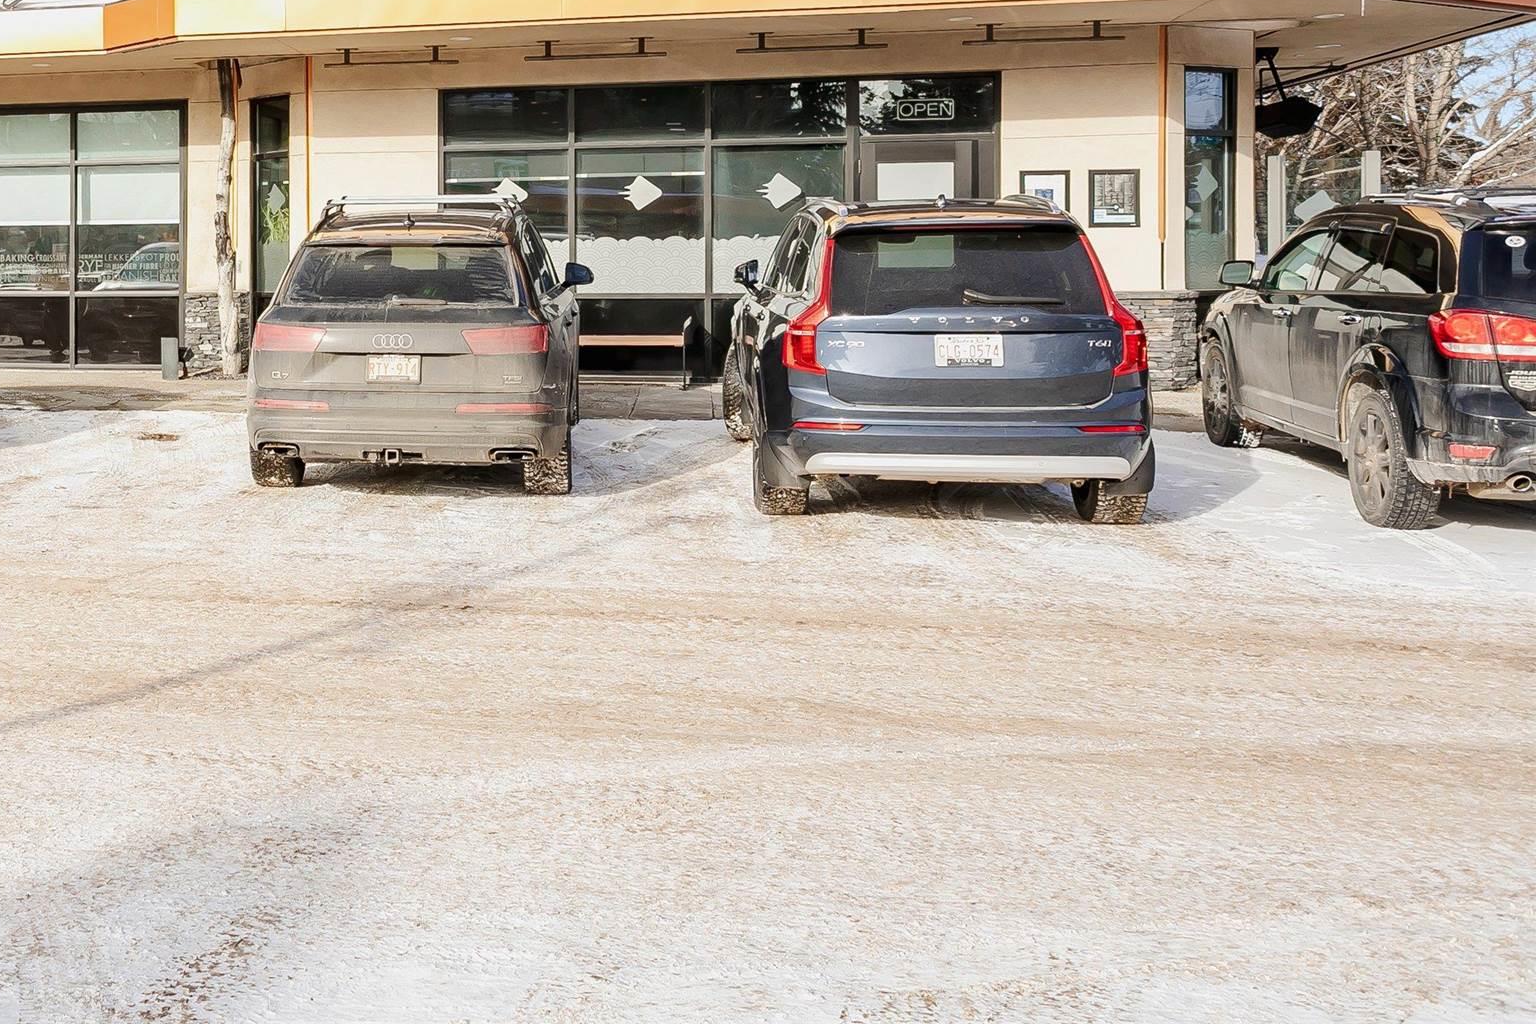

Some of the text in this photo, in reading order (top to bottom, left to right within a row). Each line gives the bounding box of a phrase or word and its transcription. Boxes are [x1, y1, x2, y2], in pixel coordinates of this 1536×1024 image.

[899, 102, 952, 117] OPEN
[0, 254, 34, 263] BAKING
[79, 259, 103, 273] RYE
[271, 371, 289, 380] Q7
